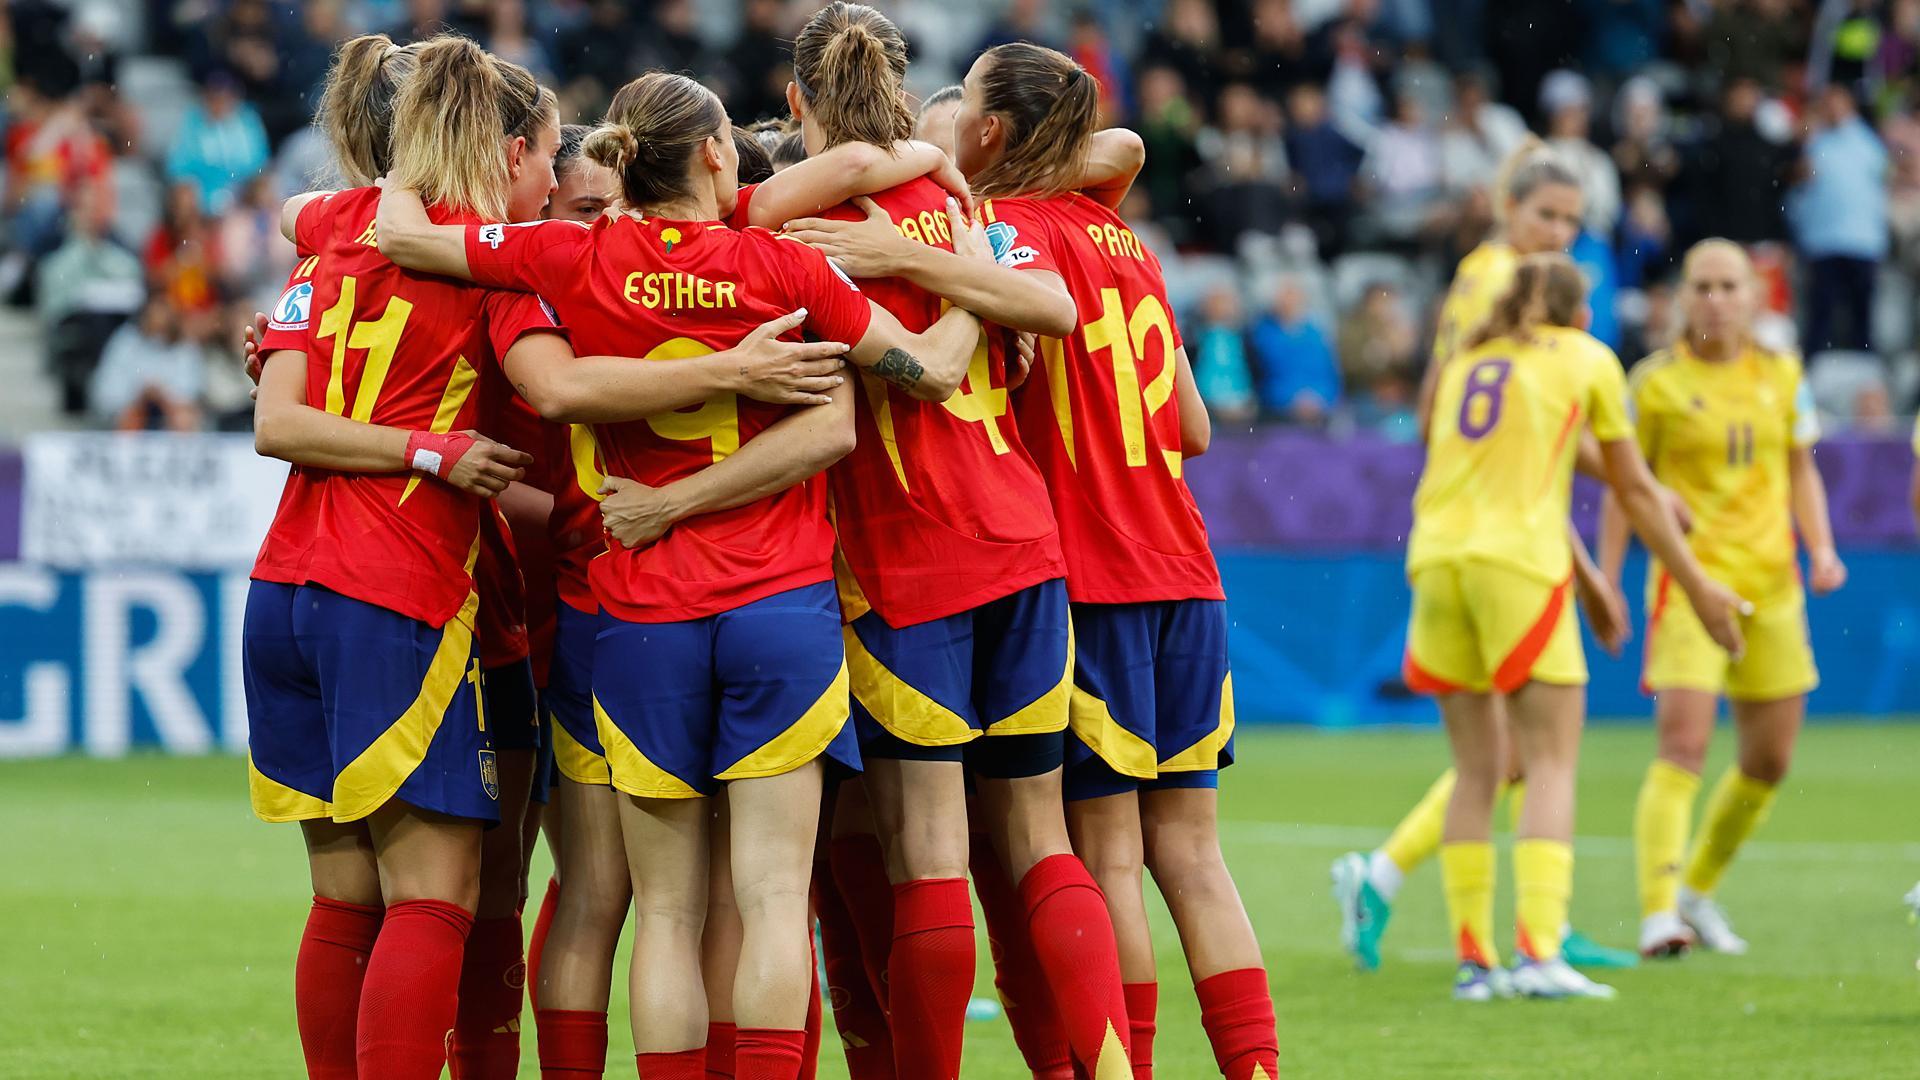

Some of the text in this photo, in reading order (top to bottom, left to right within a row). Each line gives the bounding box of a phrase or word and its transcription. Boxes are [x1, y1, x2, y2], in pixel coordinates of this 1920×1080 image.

[316, 275, 414, 425] 11
[623, 271, 737, 310] ESTHER
[640, 336, 741, 464] 9
[939, 325, 1011, 456] 4
[1083, 287, 1183, 480] 12
[1458, 357, 1511, 441] 8
[1726, 421, 1754, 466] 11
